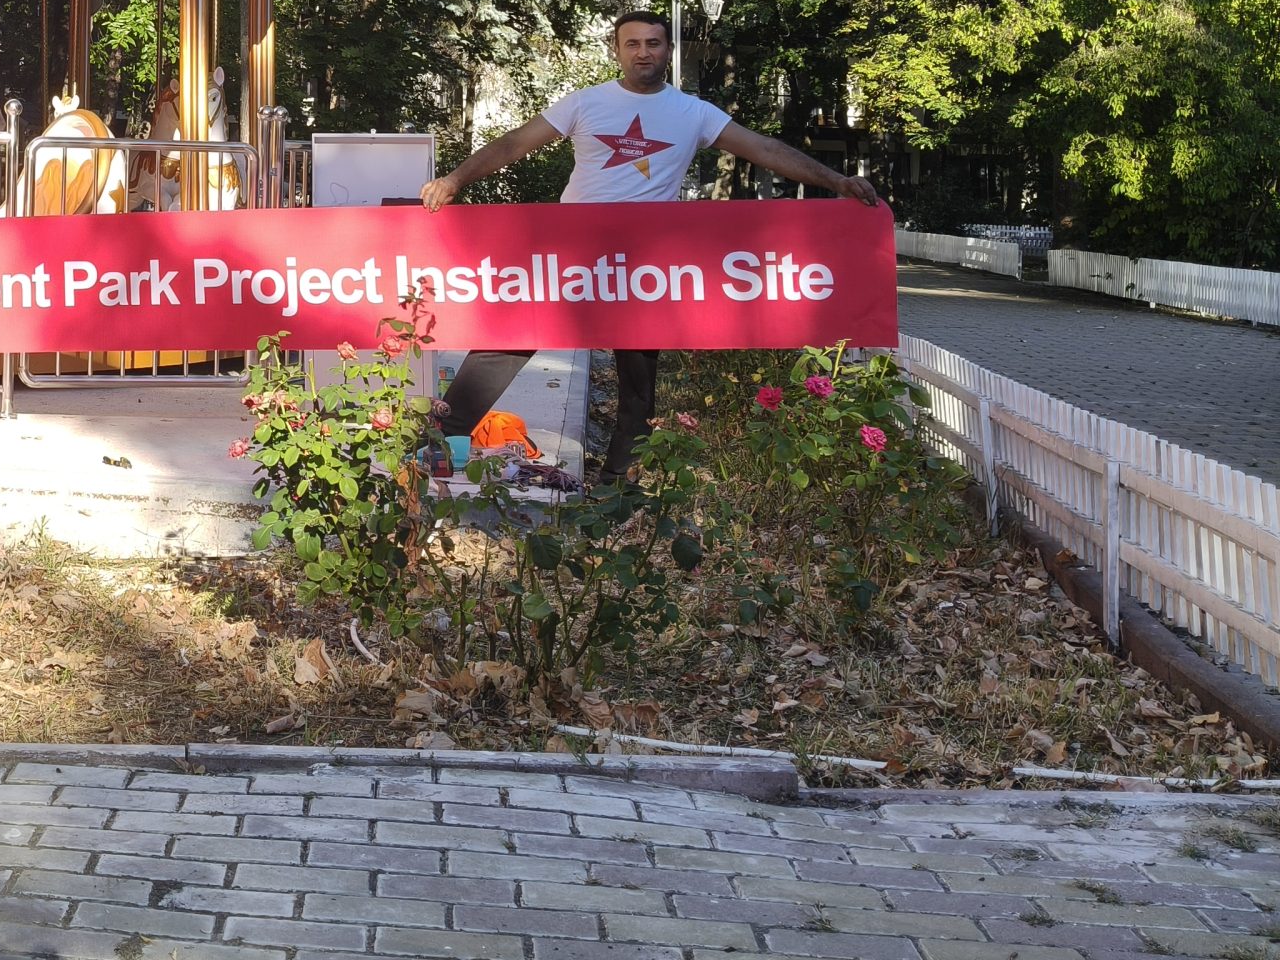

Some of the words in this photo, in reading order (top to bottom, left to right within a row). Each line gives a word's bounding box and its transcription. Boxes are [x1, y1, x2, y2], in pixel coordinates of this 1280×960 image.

[64, 258, 180, 307] Park
[193, 256, 384, 317] Project
[395, 252, 705, 305] Installation
[721, 250, 835, 302] Site
